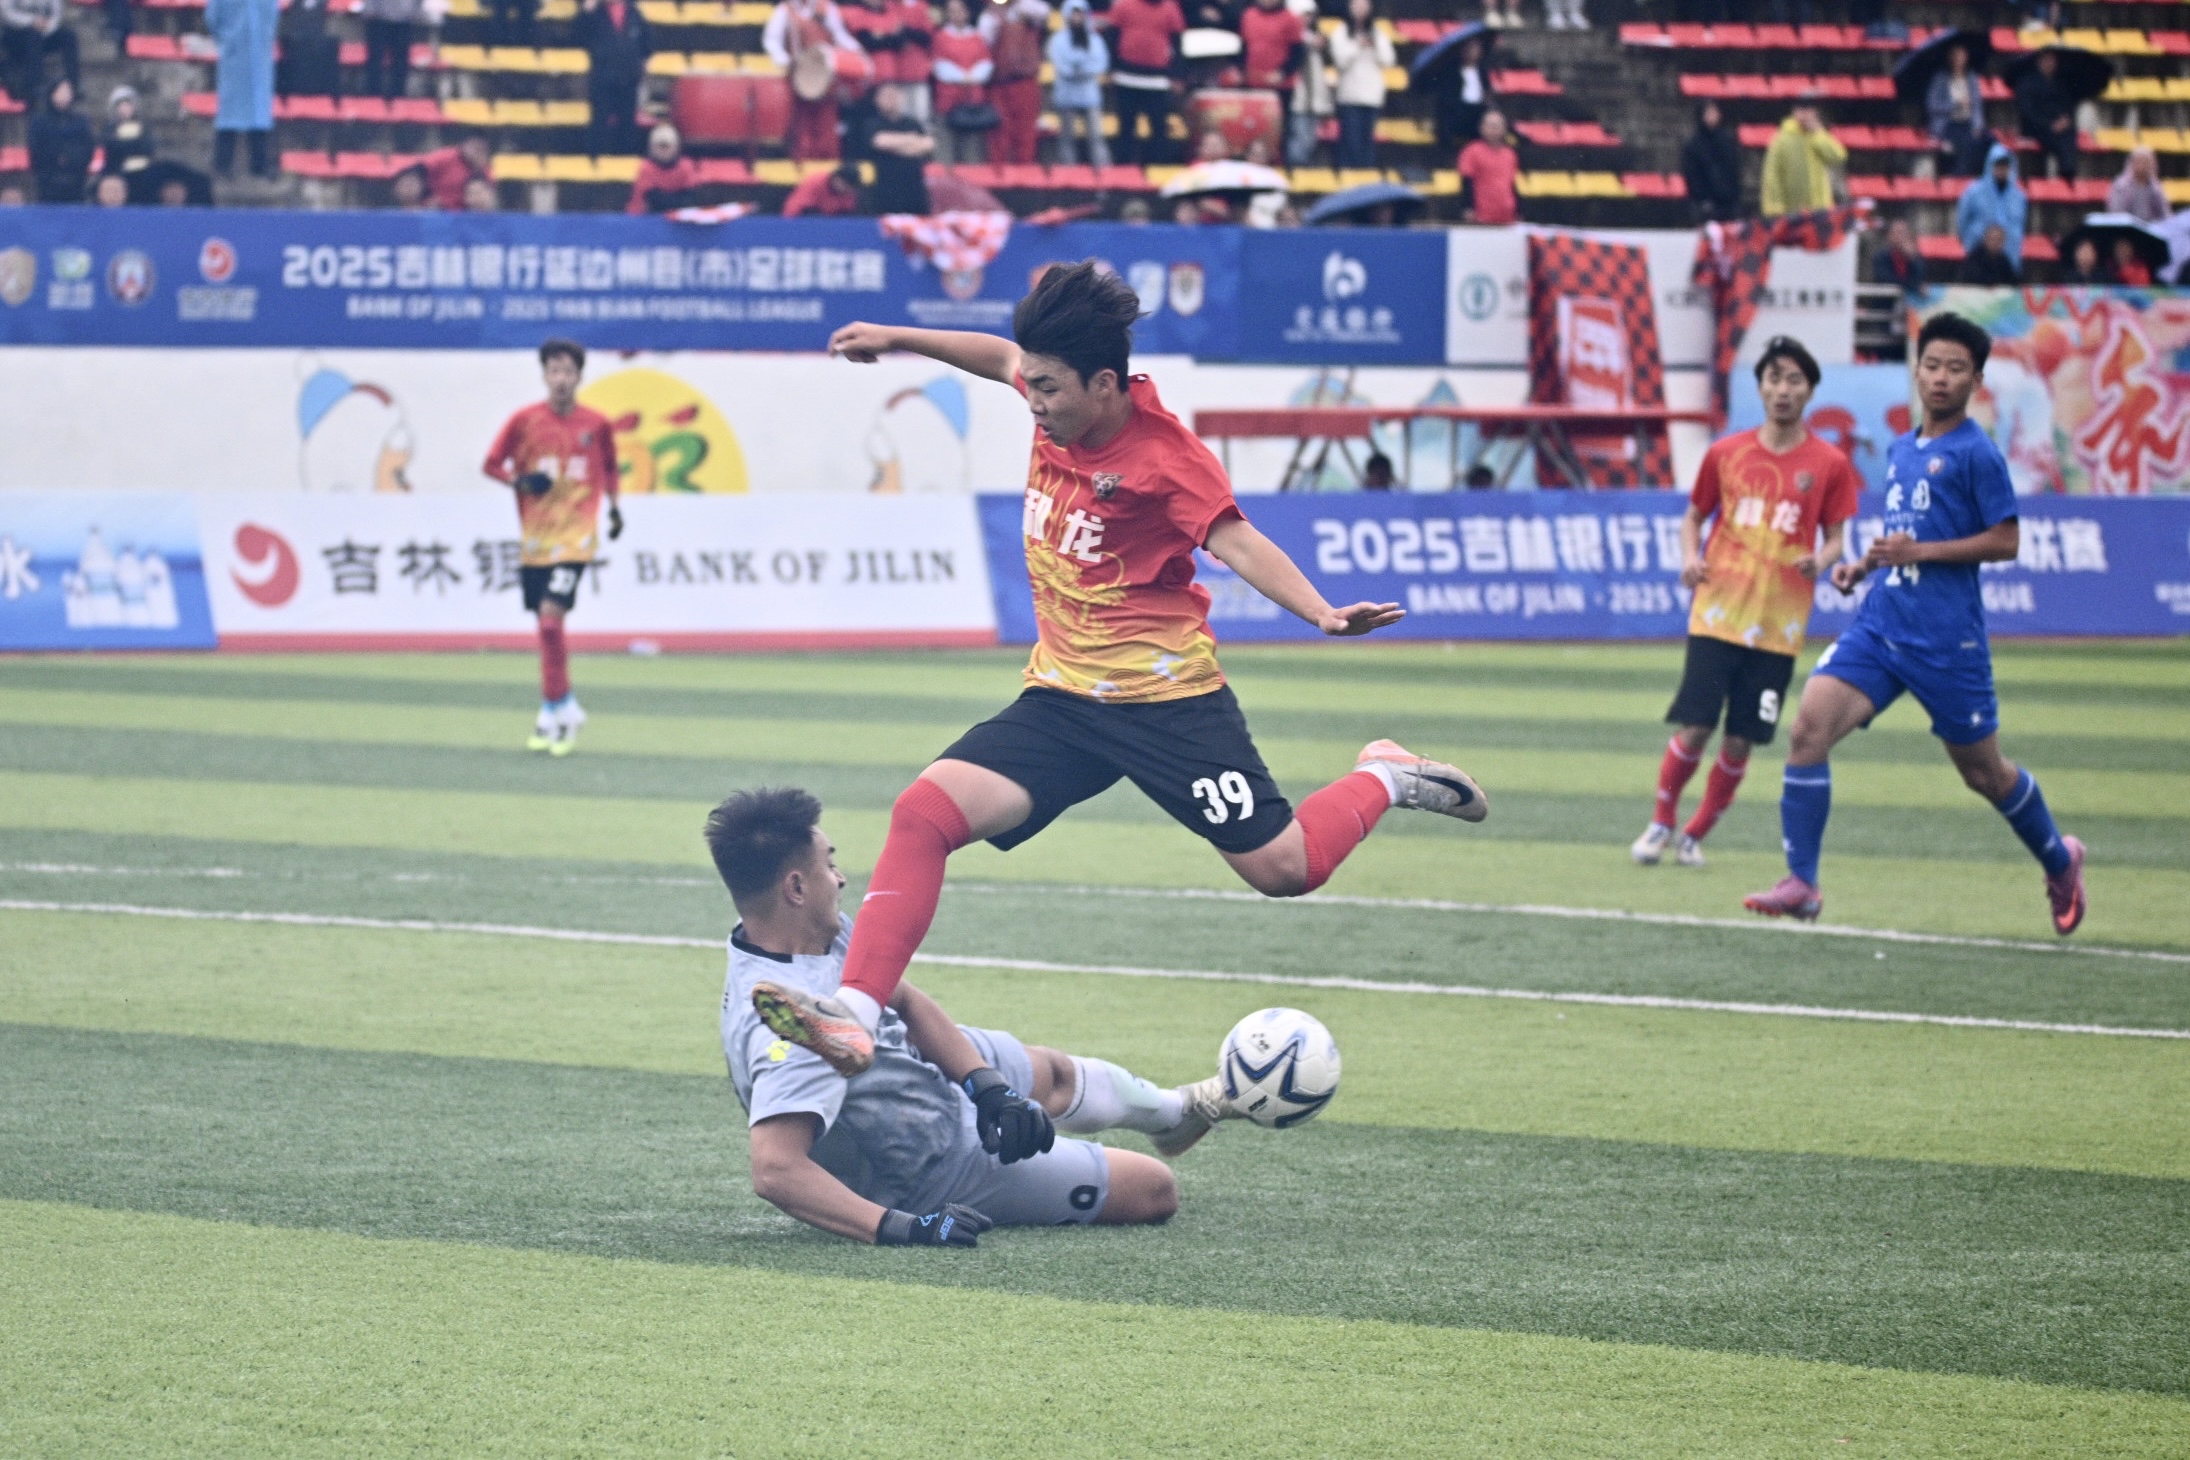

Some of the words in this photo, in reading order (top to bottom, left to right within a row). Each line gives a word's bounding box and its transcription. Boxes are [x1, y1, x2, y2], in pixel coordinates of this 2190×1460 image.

[323, 536, 609, 597] 吉林银
[635, 550, 760, 587] BANK
[769, 550, 823, 585] OF
[840, 548, 957, 584] JILIN
[1191, 770, 1254, 824] 39
[939, 1214, 955, 1241] SGP
